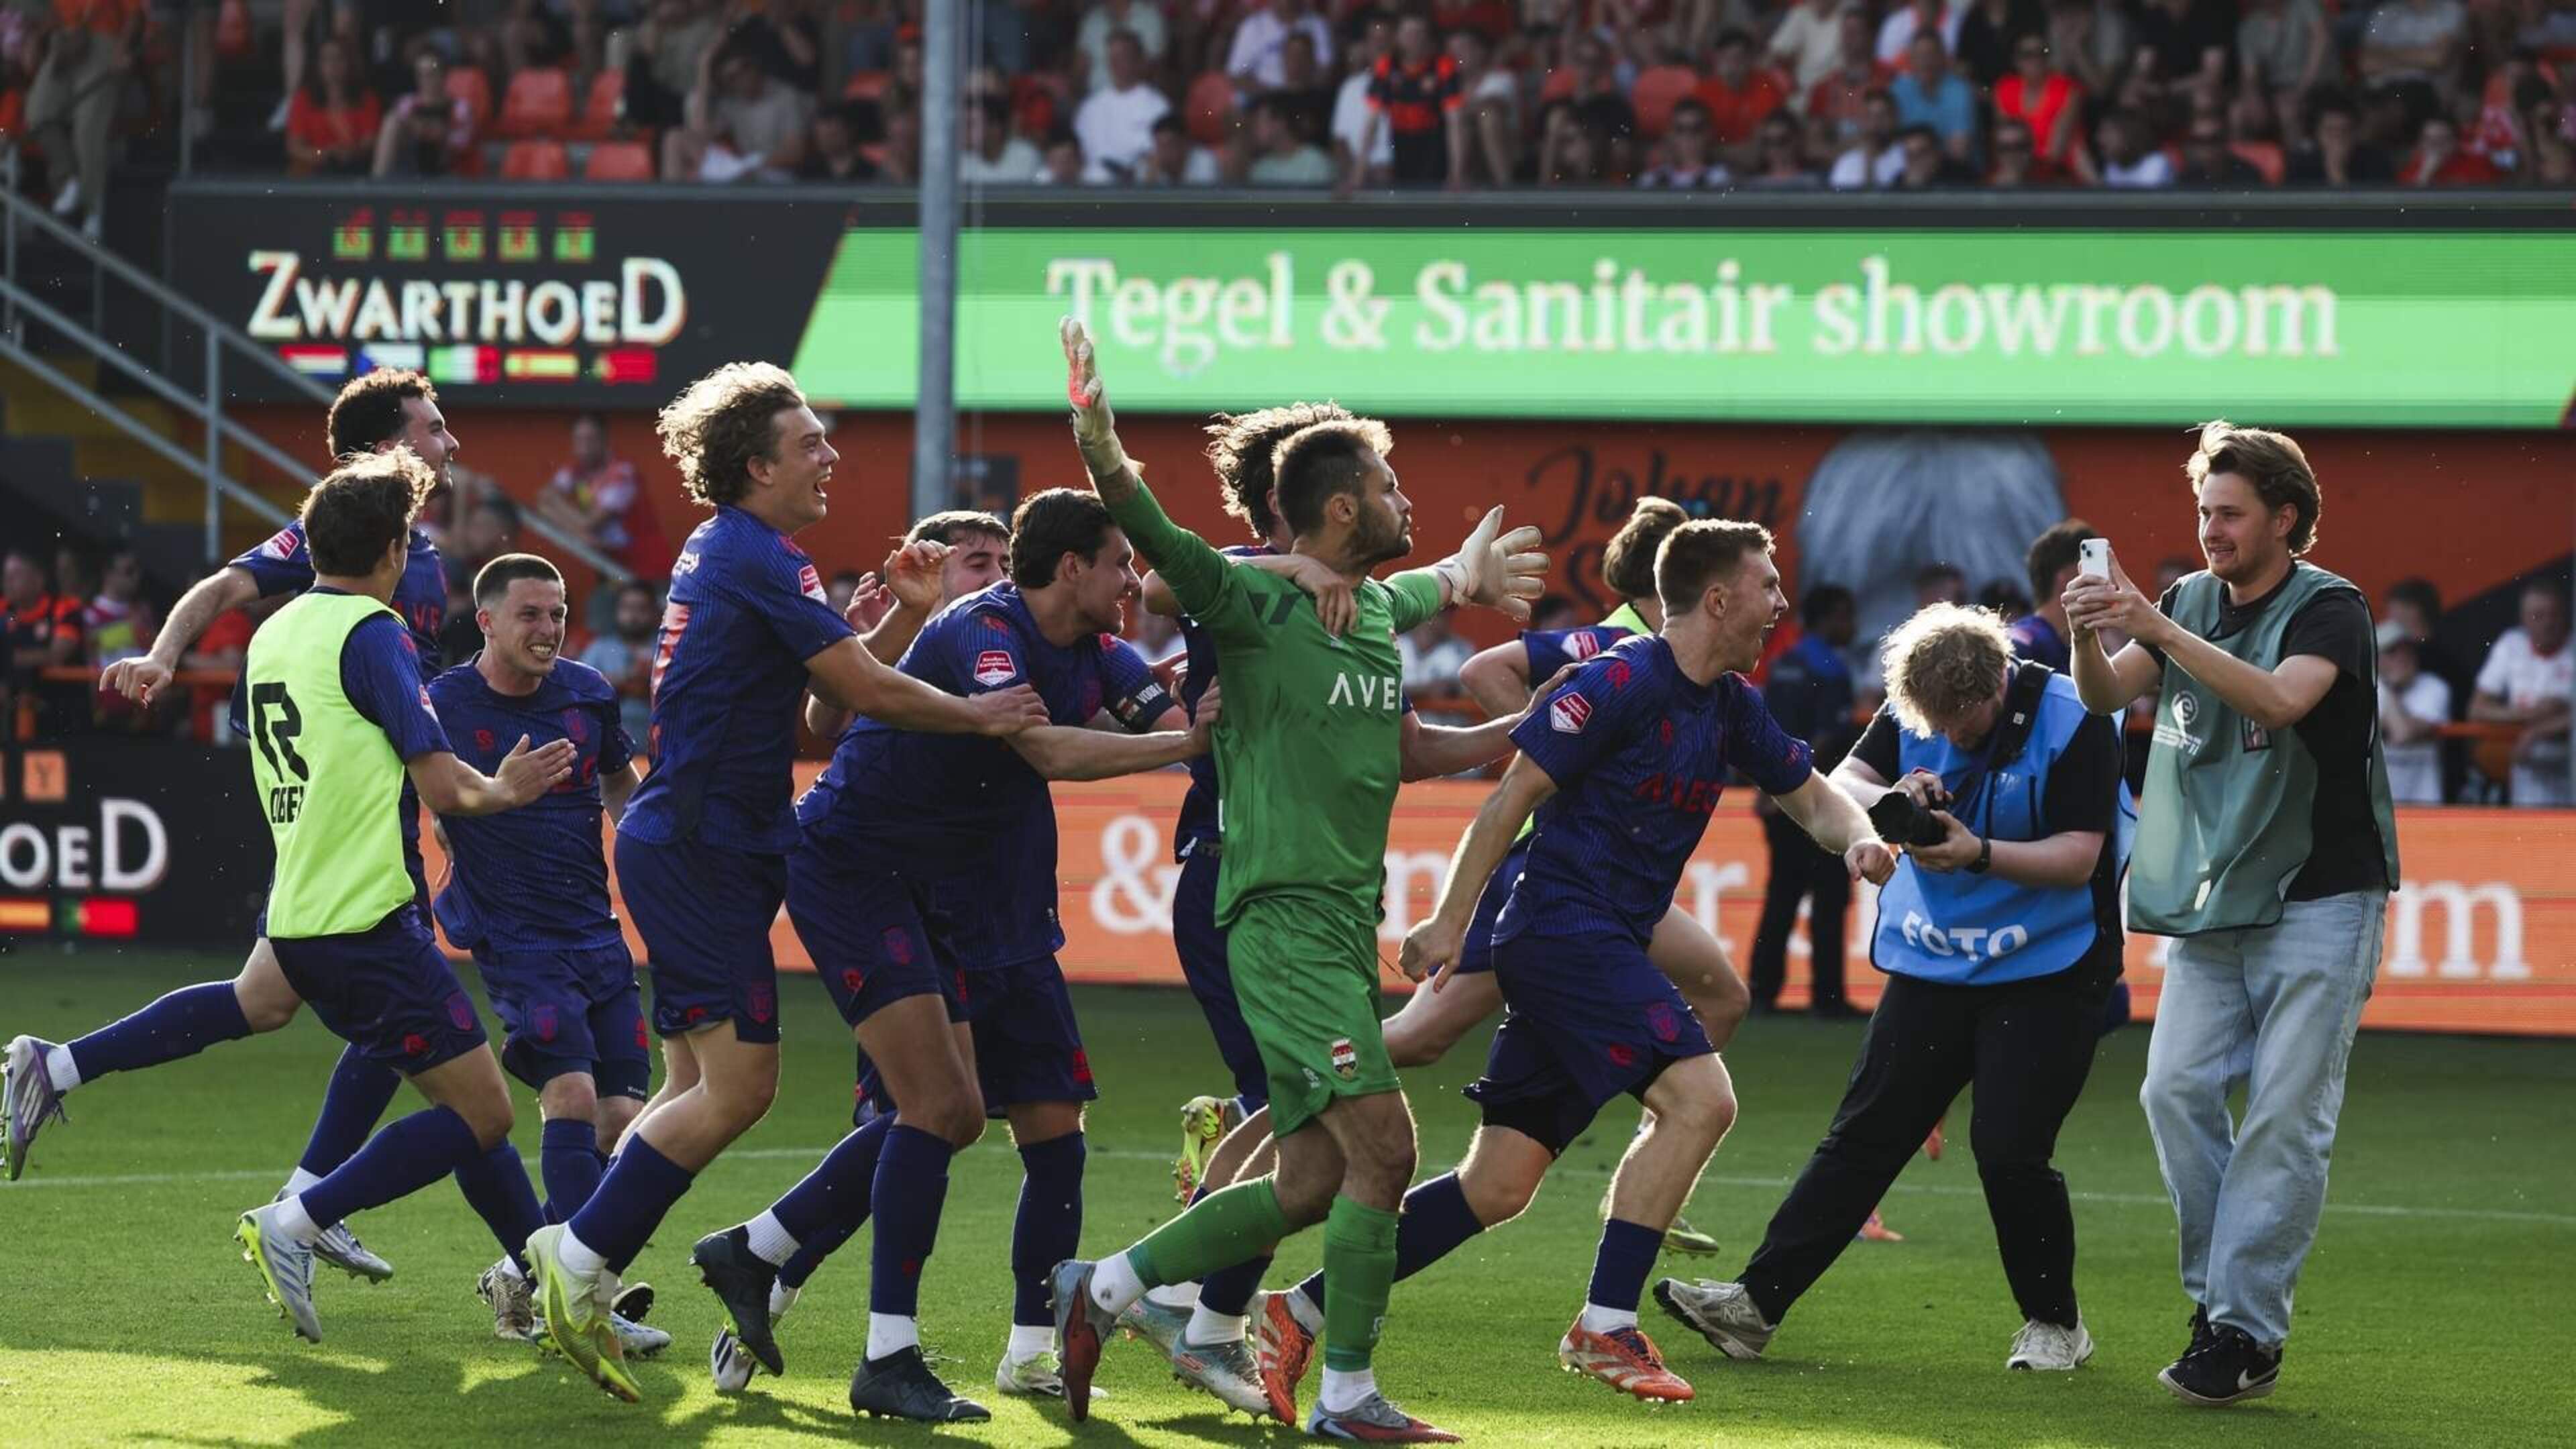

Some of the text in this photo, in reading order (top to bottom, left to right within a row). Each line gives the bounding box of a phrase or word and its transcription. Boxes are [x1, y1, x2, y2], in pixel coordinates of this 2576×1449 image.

[247, 250, 686, 345] ZWARTHOED
[1047, 252, 2340, 377] Tegel & Sanitair showroom
[1328, 672, 1403, 710] AVE
[1902, 910, 2027, 961] FOTO
